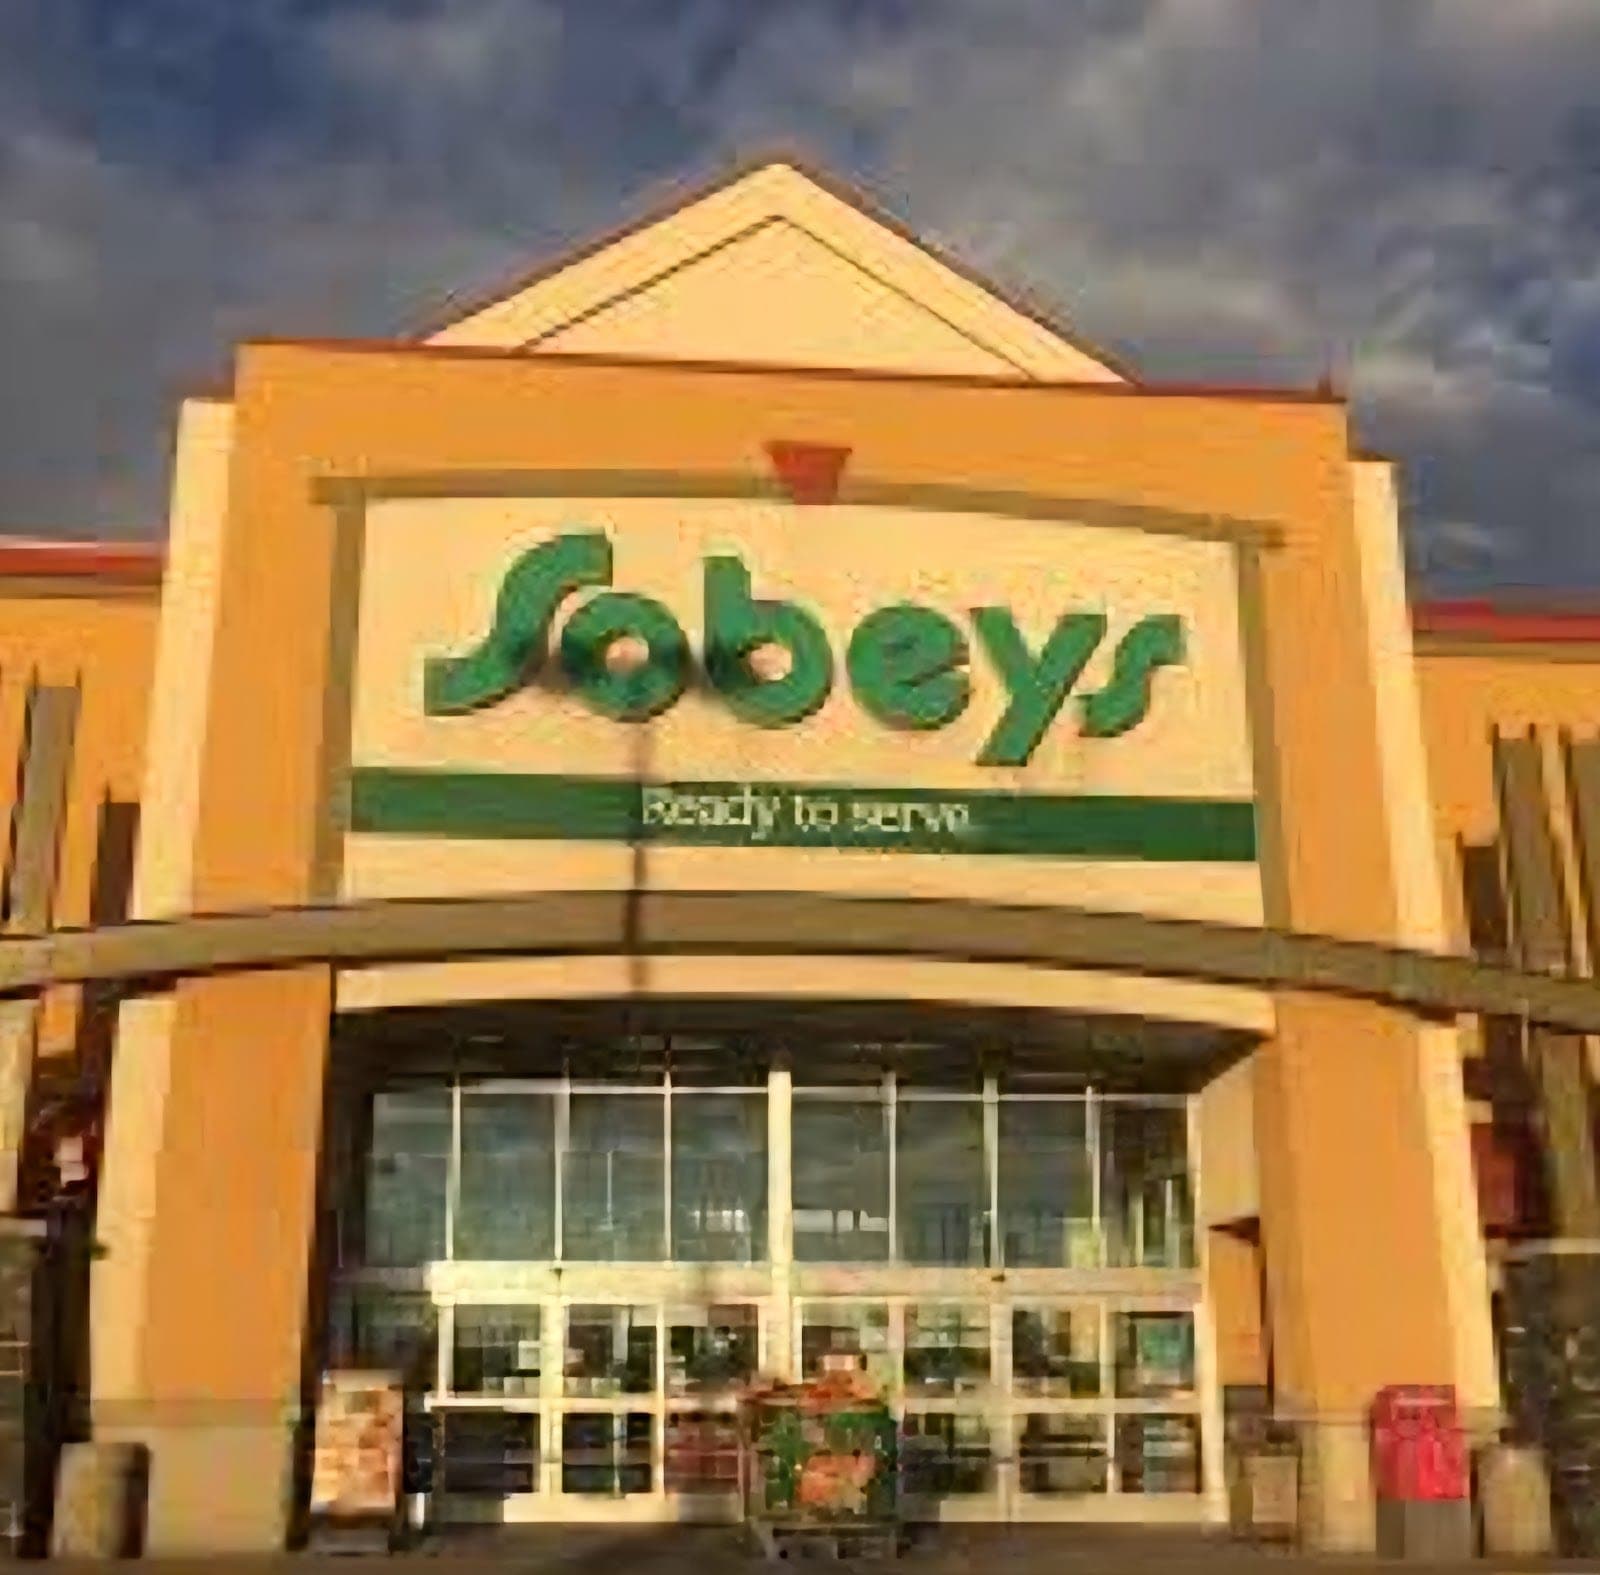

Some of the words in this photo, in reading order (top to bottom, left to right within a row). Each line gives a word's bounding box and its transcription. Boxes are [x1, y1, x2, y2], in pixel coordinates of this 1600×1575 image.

[423, 530, 1186, 767] Sobeys
[641, 784, 780, 840] Ready
[794, 795, 838, 828] to
[853, 801, 969, 833] serve
